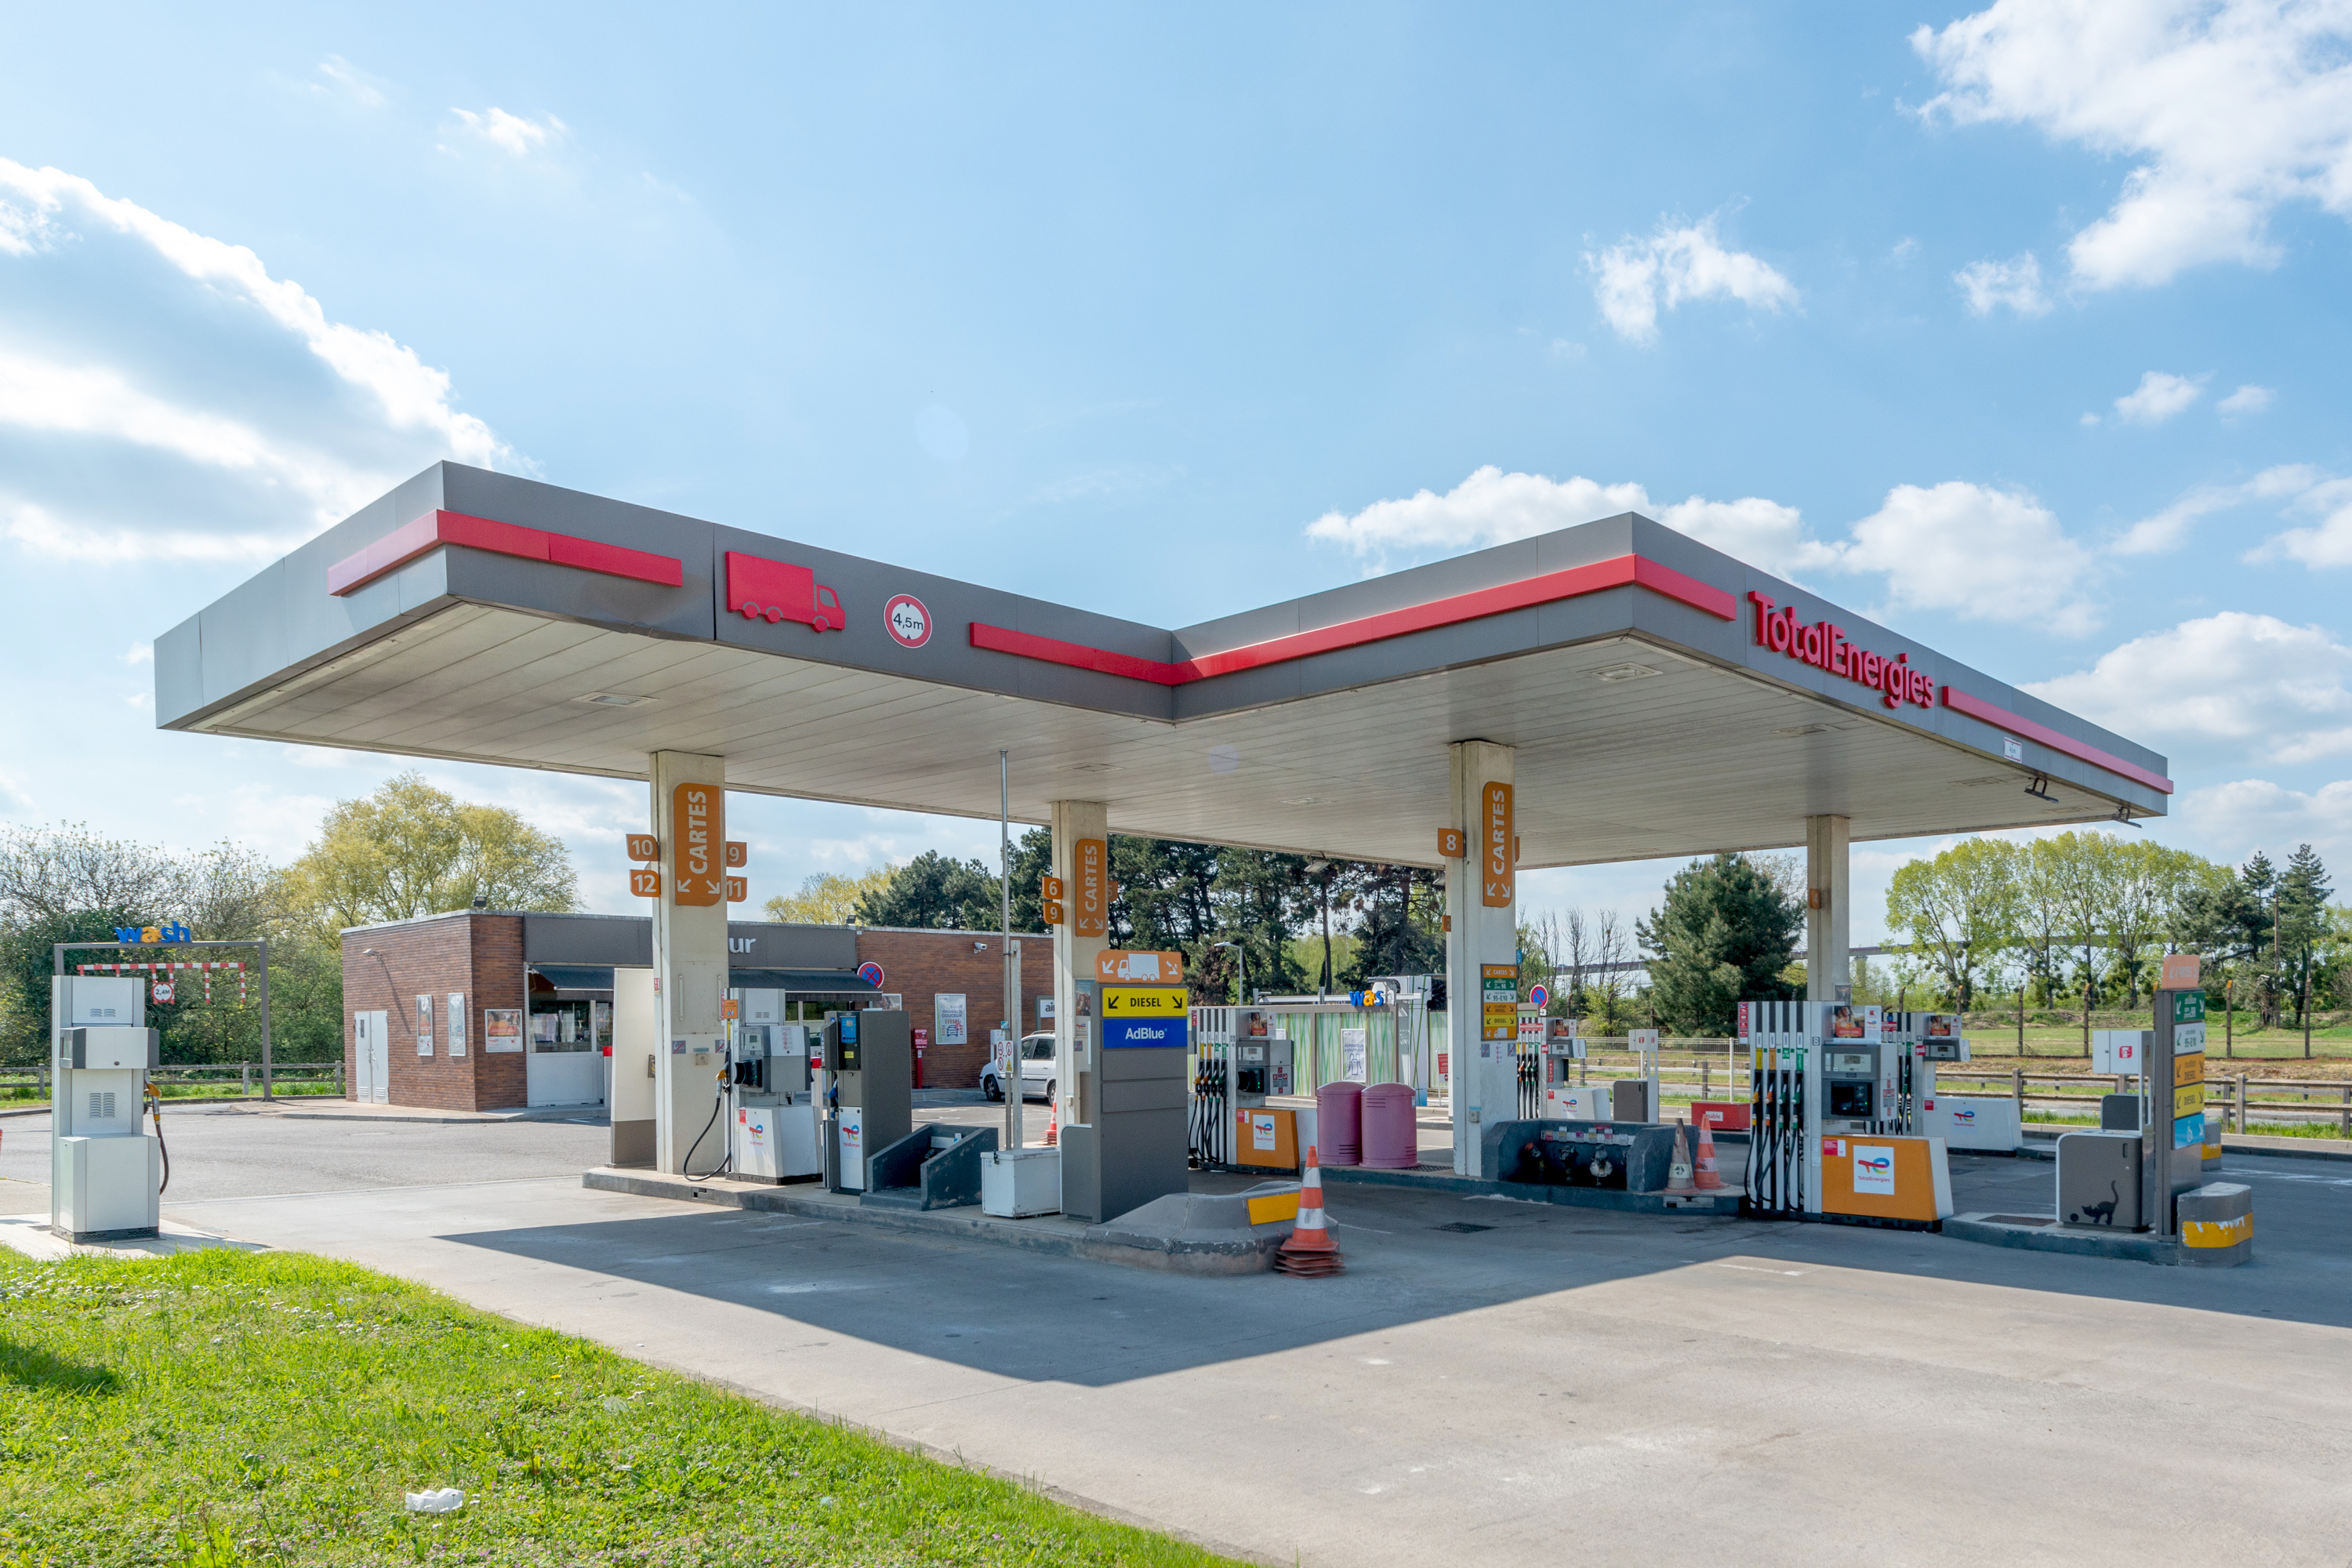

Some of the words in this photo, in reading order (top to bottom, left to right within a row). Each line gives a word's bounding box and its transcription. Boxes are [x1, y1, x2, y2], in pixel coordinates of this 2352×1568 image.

[893, 612, 924, 631] 4,5m
[1748, 590, 1934, 709] TotalEnergies
[688, 791, 708, 874] CARTES
[1493, 789, 1504, 875] CARTES
[632, 839, 653, 855] 10
[1446, 834, 1457, 851] 8
[728, 847, 739, 862] 9
[633, 874, 657, 893] 12
[1085, 844, 1098, 912] CARTES
[726, 880, 742, 898] 11
[1049, 881, 1058, 895] 6
[1050, 906, 1058, 920] 9
[114, 920, 191, 943] wash
[1130, 997, 1161, 1007] DIESEL
[1125, 1028, 1165, 1040] AdBlue
